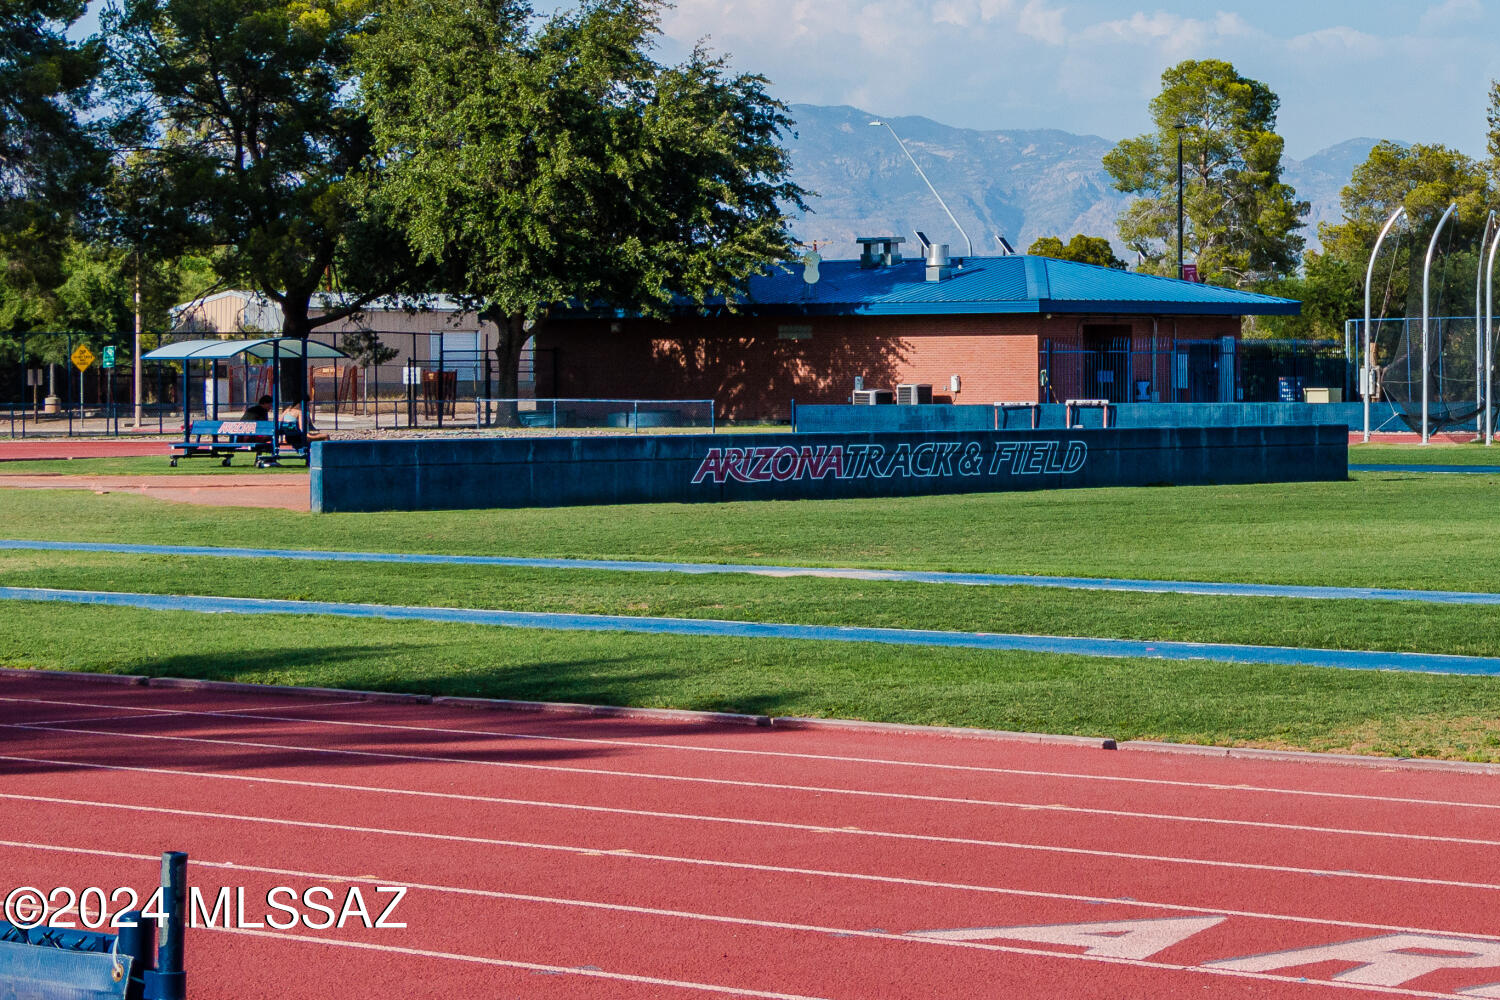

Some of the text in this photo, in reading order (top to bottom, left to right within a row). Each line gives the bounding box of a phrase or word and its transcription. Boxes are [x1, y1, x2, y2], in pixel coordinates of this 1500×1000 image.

[690, 440, 1088, 483] ARIZONA TRACK & FIELD
